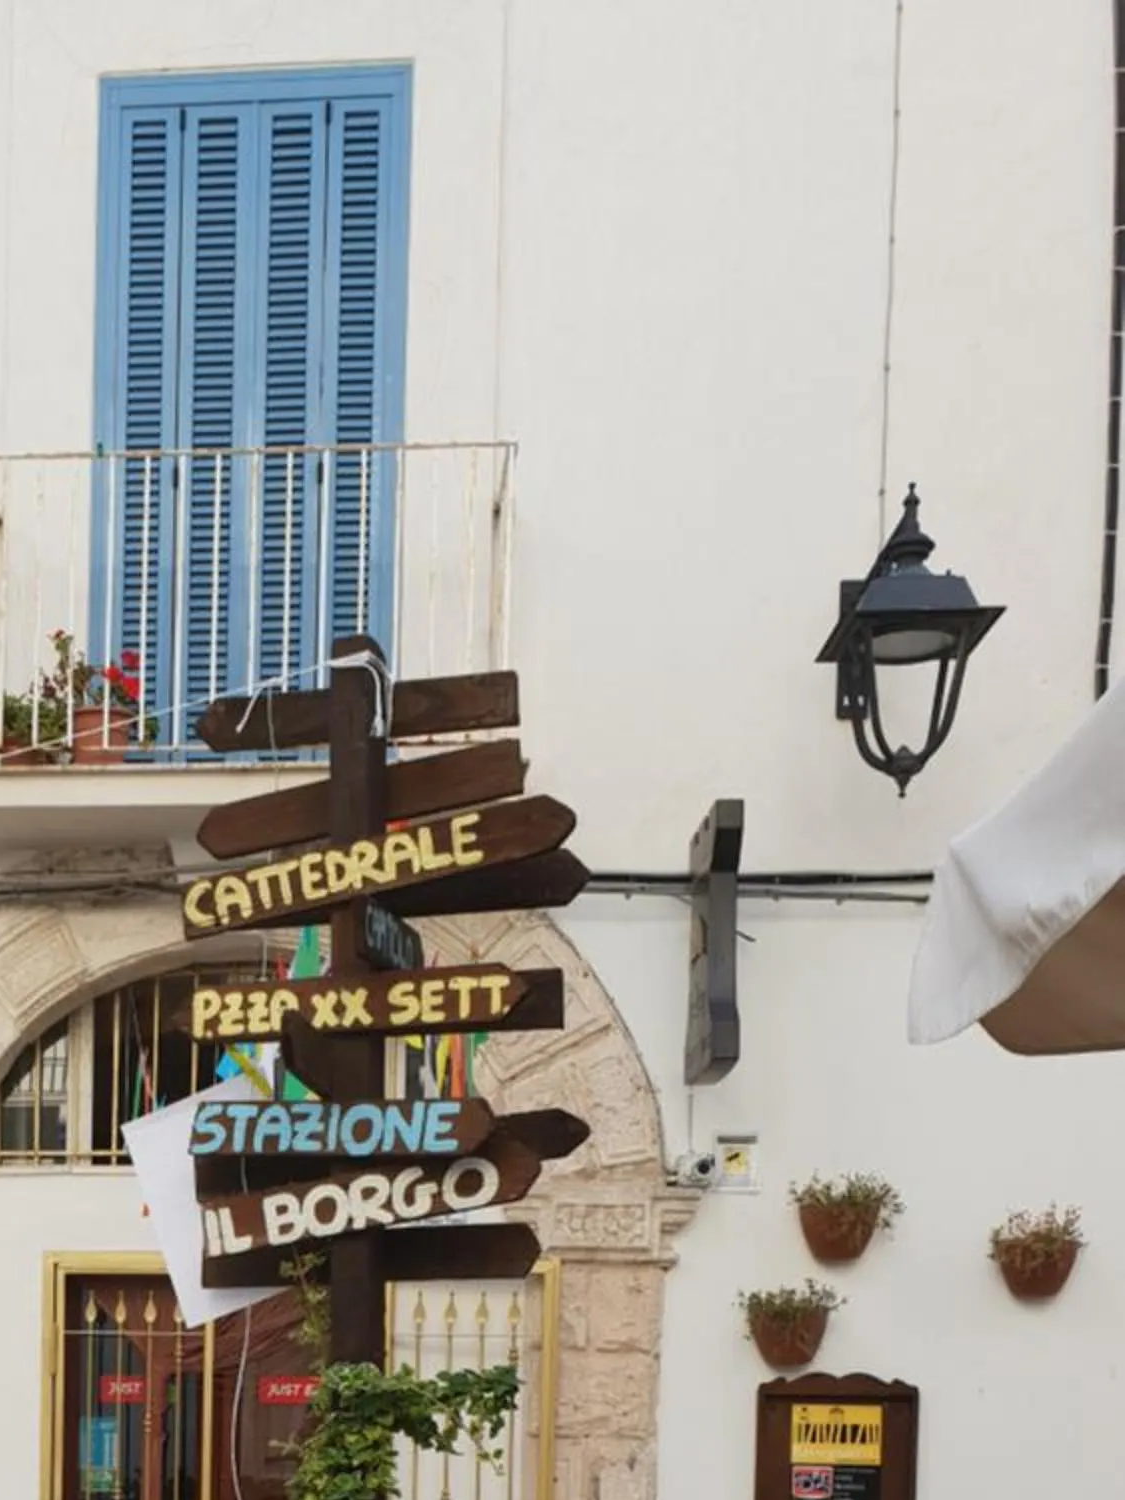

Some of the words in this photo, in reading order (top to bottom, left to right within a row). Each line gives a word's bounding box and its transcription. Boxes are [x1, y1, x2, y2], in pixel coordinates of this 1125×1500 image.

[184, 813, 485, 928] CATTEDRALE
[311, 985, 373, 1029] XX
[189, 1101, 462, 1157] STAZIONE
[204, 1207, 253, 1257] IL
[262, 1156, 500, 1247] BORGO
[266, 1383, 302, 1398] JUST
